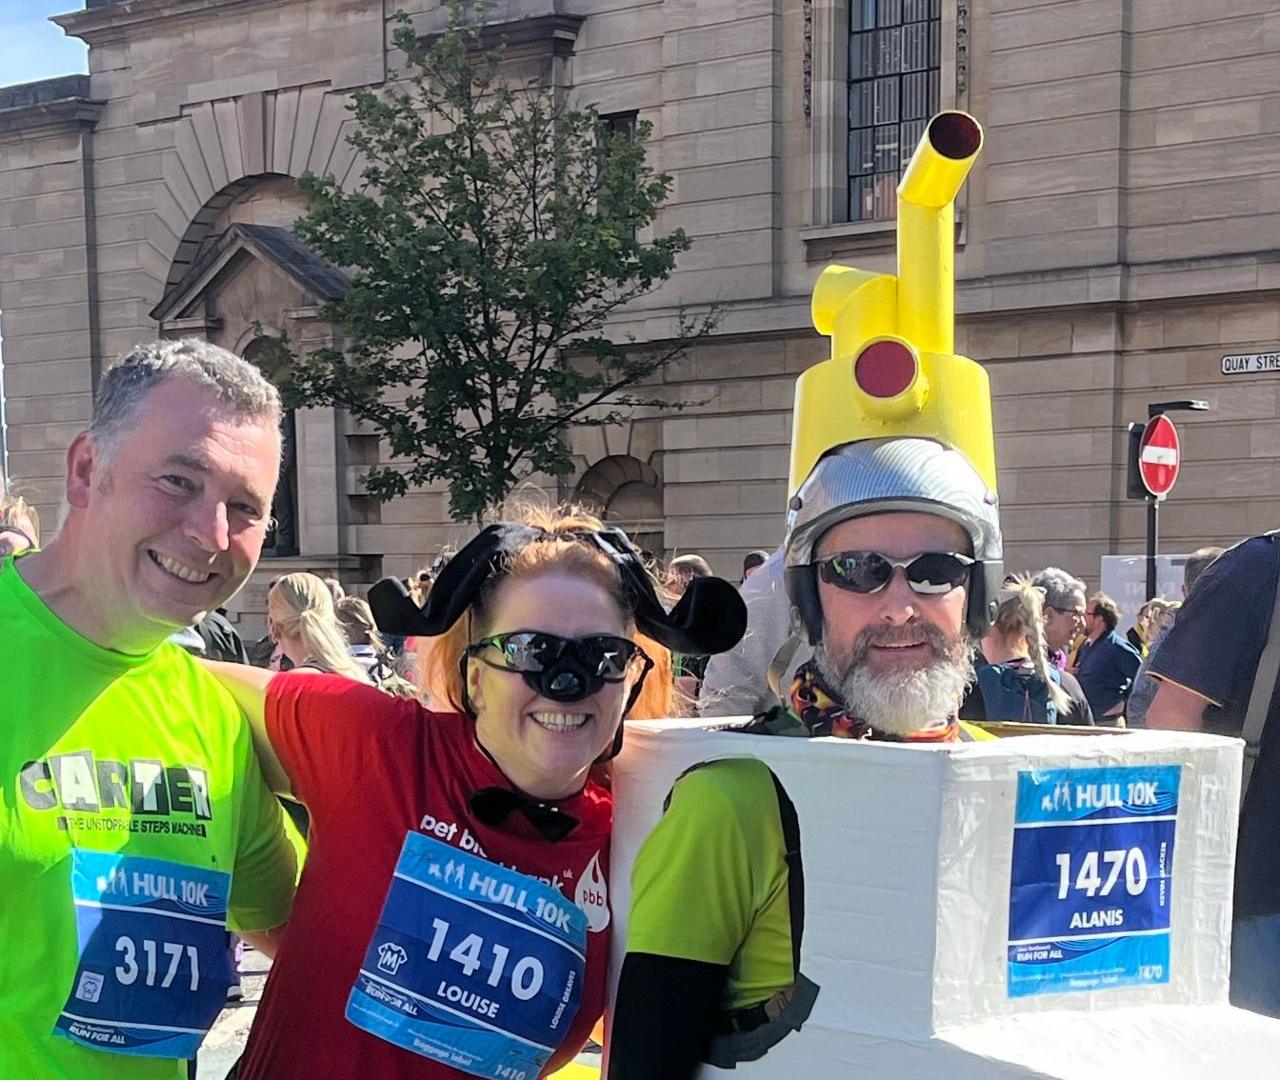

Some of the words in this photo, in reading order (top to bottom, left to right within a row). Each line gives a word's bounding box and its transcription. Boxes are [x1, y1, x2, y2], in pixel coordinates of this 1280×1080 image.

[1224, 357, 1250, 371] QUAY
[19, 752, 212, 819] CARTER
[1076, 783, 1122, 809] HULL
[1126, 782, 1158, 806] 10K
[140, 820, 169, 834] STEPS
[420, 814, 458, 841] pet
[1055, 846, 1148, 900] 1470
[133, 871, 178, 902] HULL
[180, 880, 209, 907] 10K
[468, 871, 529, 913] HULL
[534, 896, 571, 933] 10K
[583, 888, 605, 907] pbb
[1069, 909, 1124, 929] ALANIS
[114, 935, 200, 992] 3171
[425, 917, 545, 1001] 1410
[1016, 951, 1033, 962] RUN
[1034, 951, 1048, 961] FOR
[1049, 949, 1063, 960] ALL
[402, 1002, 418, 1016] ALL
[436, 980, 501, 1019] LOUISE
[550, 1002, 566, 1029] LOUISE
[69, 1025, 91, 1039] RUN
[90, 1031, 110, 1042] FOR
[110, 1034, 126, 1044] ALL
